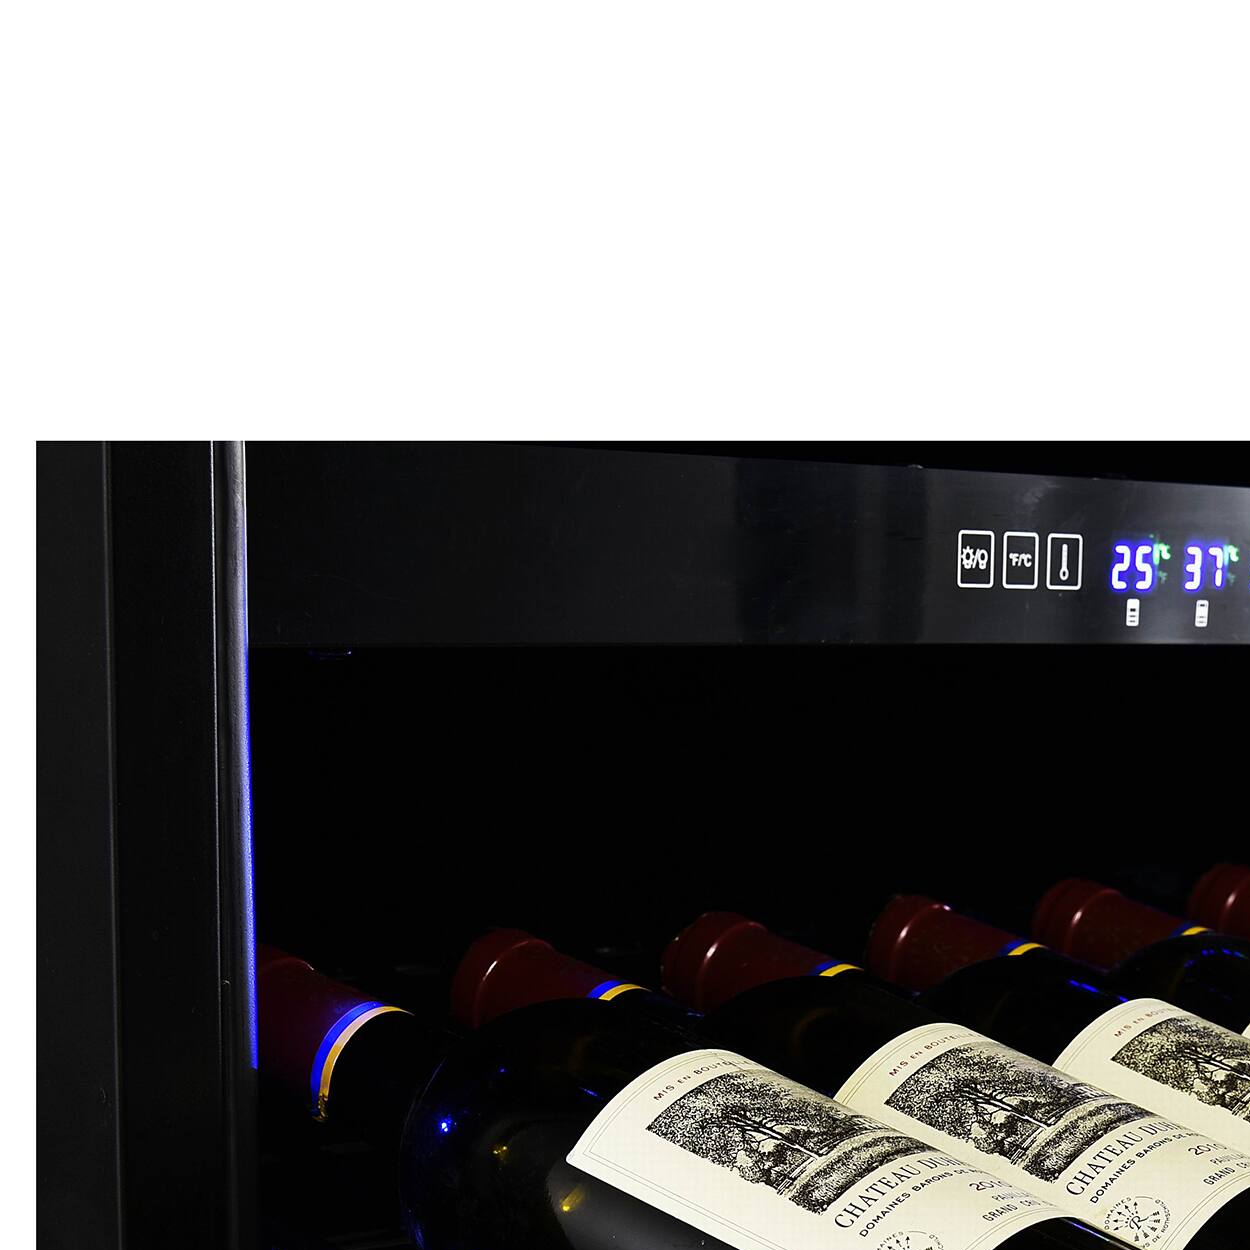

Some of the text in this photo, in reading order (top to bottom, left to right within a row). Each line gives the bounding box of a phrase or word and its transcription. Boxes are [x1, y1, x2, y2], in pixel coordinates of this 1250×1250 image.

[1111, 545, 1153, 590] 25
[1184, 546, 1224, 590] 37
[1114, 1024, 1132, 1037] MIS
[889, 1061, 909, 1076] MIS
[910, 1051, 923, 1060] EN
[653, 1084, 675, 1101] MIS
[677, 1074, 691, 1084] EN
[1066, 1130, 1143, 1196] CHATEAU
[1089, 1157, 1136, 1204] DOMAINES
[1135, 1137, 1173, 1158] BARONS
[1203, 1166, 1235, 1185] GRAND
[834, 1164, 921, 1229] CHATEAU
[859, 1192, 911, 1238] DOMAINES
[911, 1171, 953, 1192] BARONS
[982, 1204, 1018, 1221] GRAND
[1104, 1197, 1131, 1230] DOMAINES
